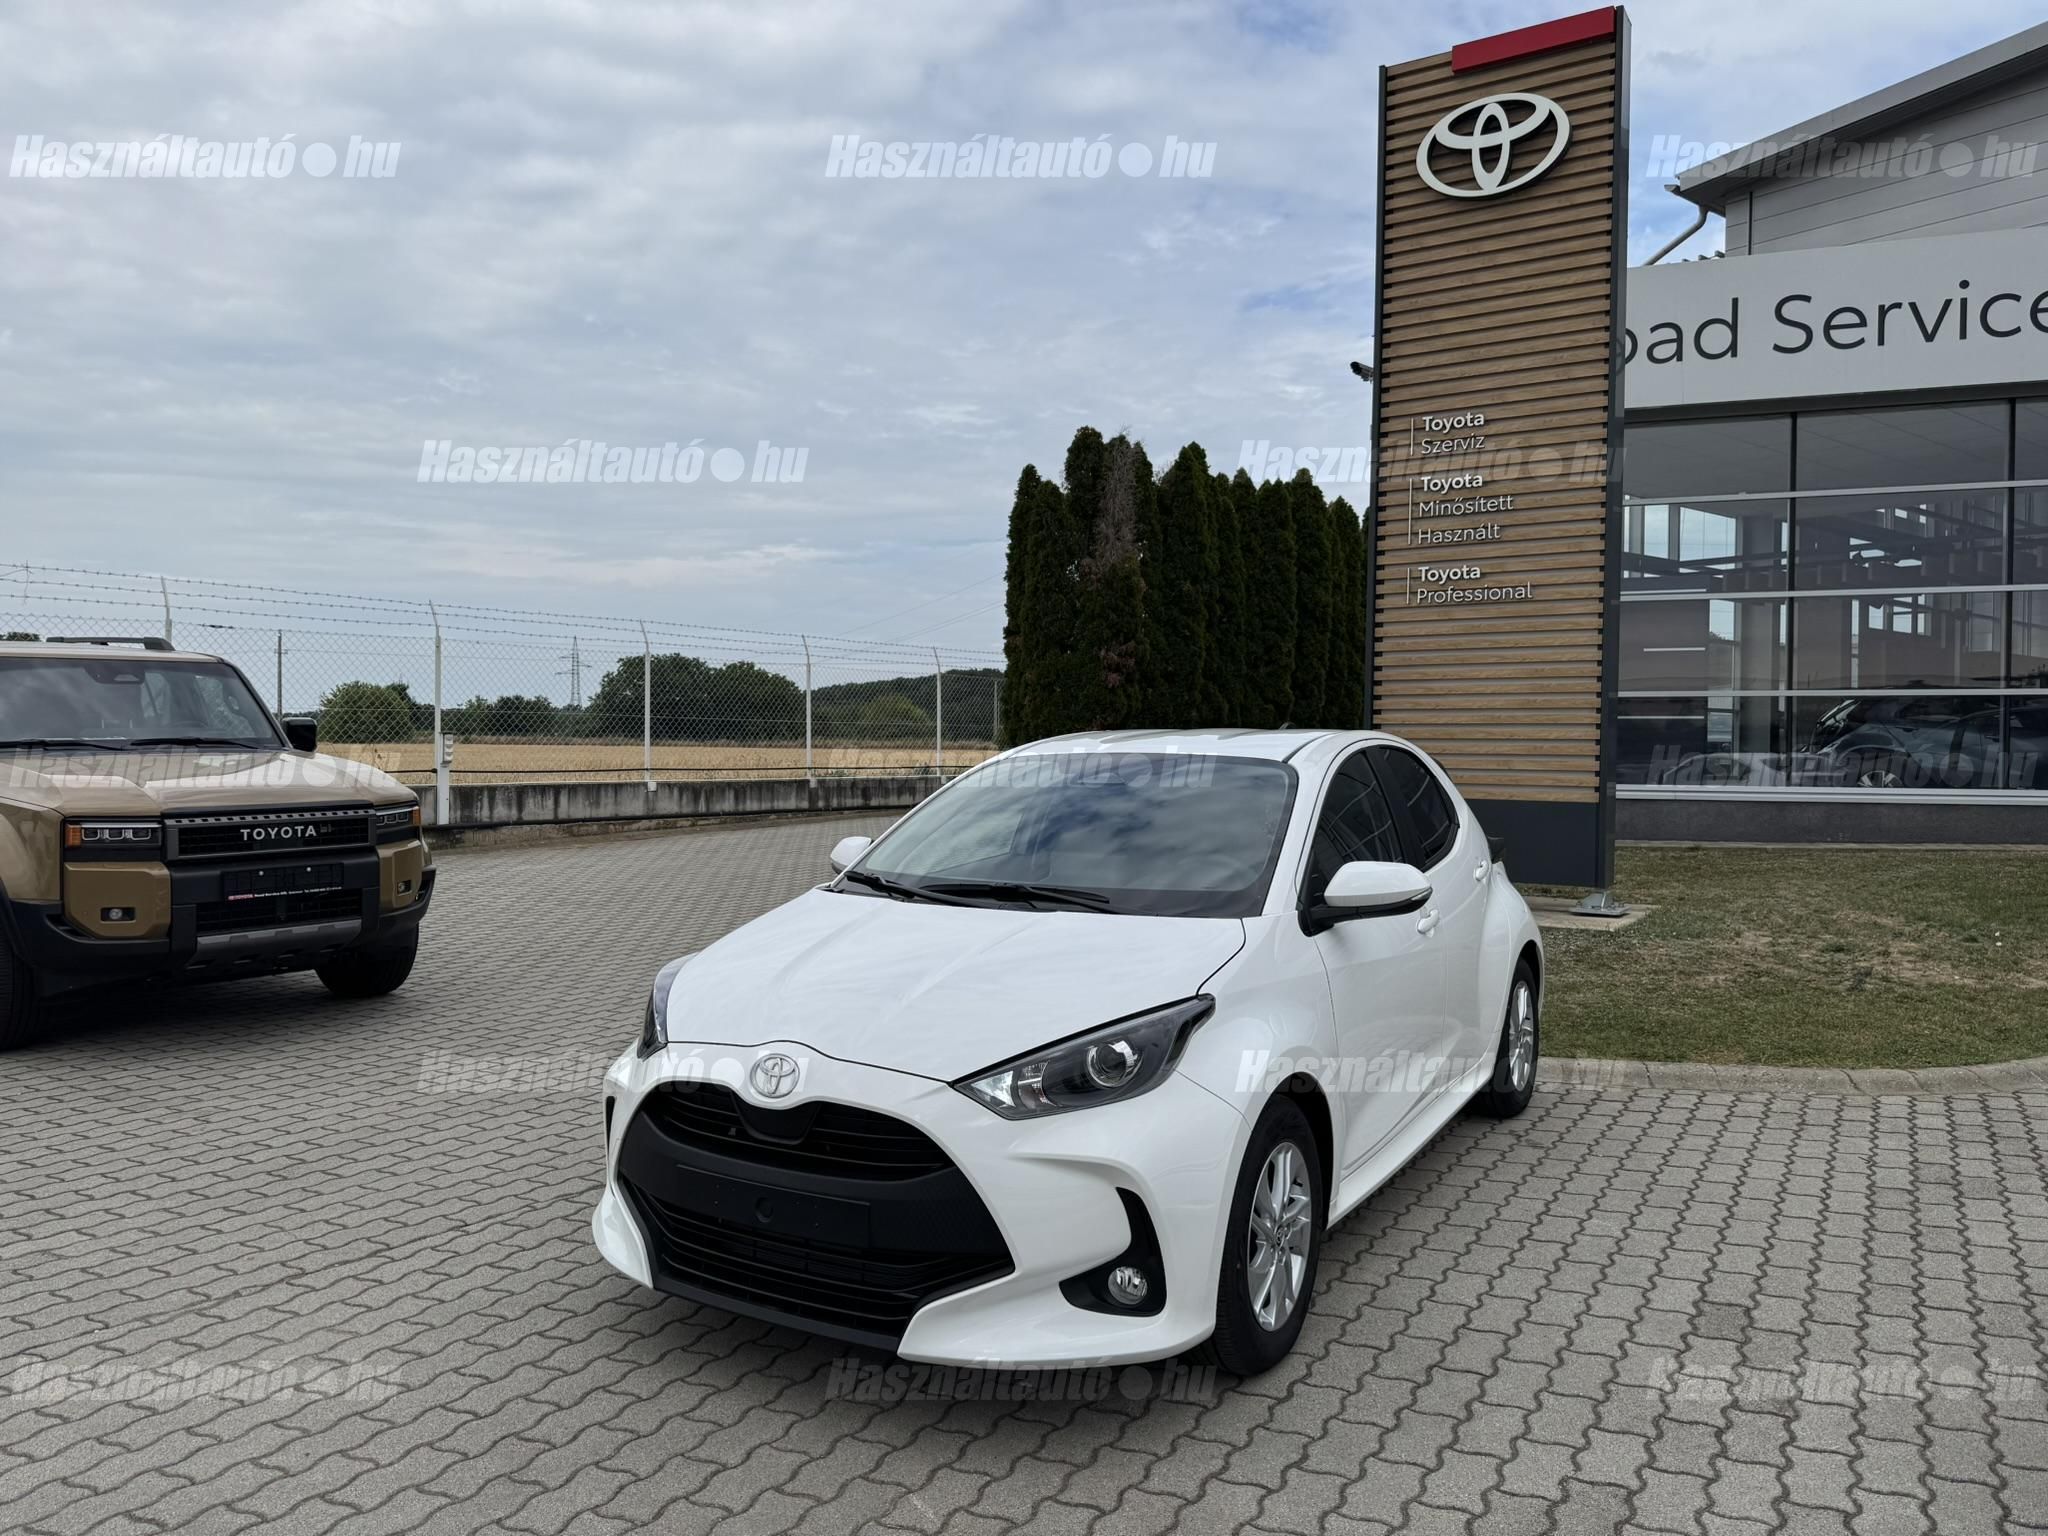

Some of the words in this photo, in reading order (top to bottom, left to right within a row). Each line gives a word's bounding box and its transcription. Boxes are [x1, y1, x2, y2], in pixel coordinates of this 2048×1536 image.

[1422, 411, 1485, 434] Toyota
[1421, 433, 1485, 455] Szerviz
[1420, 473, 1483, 494] Toyota
[1418, 495, 1514, 518] Minősített
[1417, 522, 1501, 545] Használt
[1417, 564, 1481, 585] Toyota
[1416, 581, 1533, 605] Professional
[240, 825, 317, 841] TOYOTA
